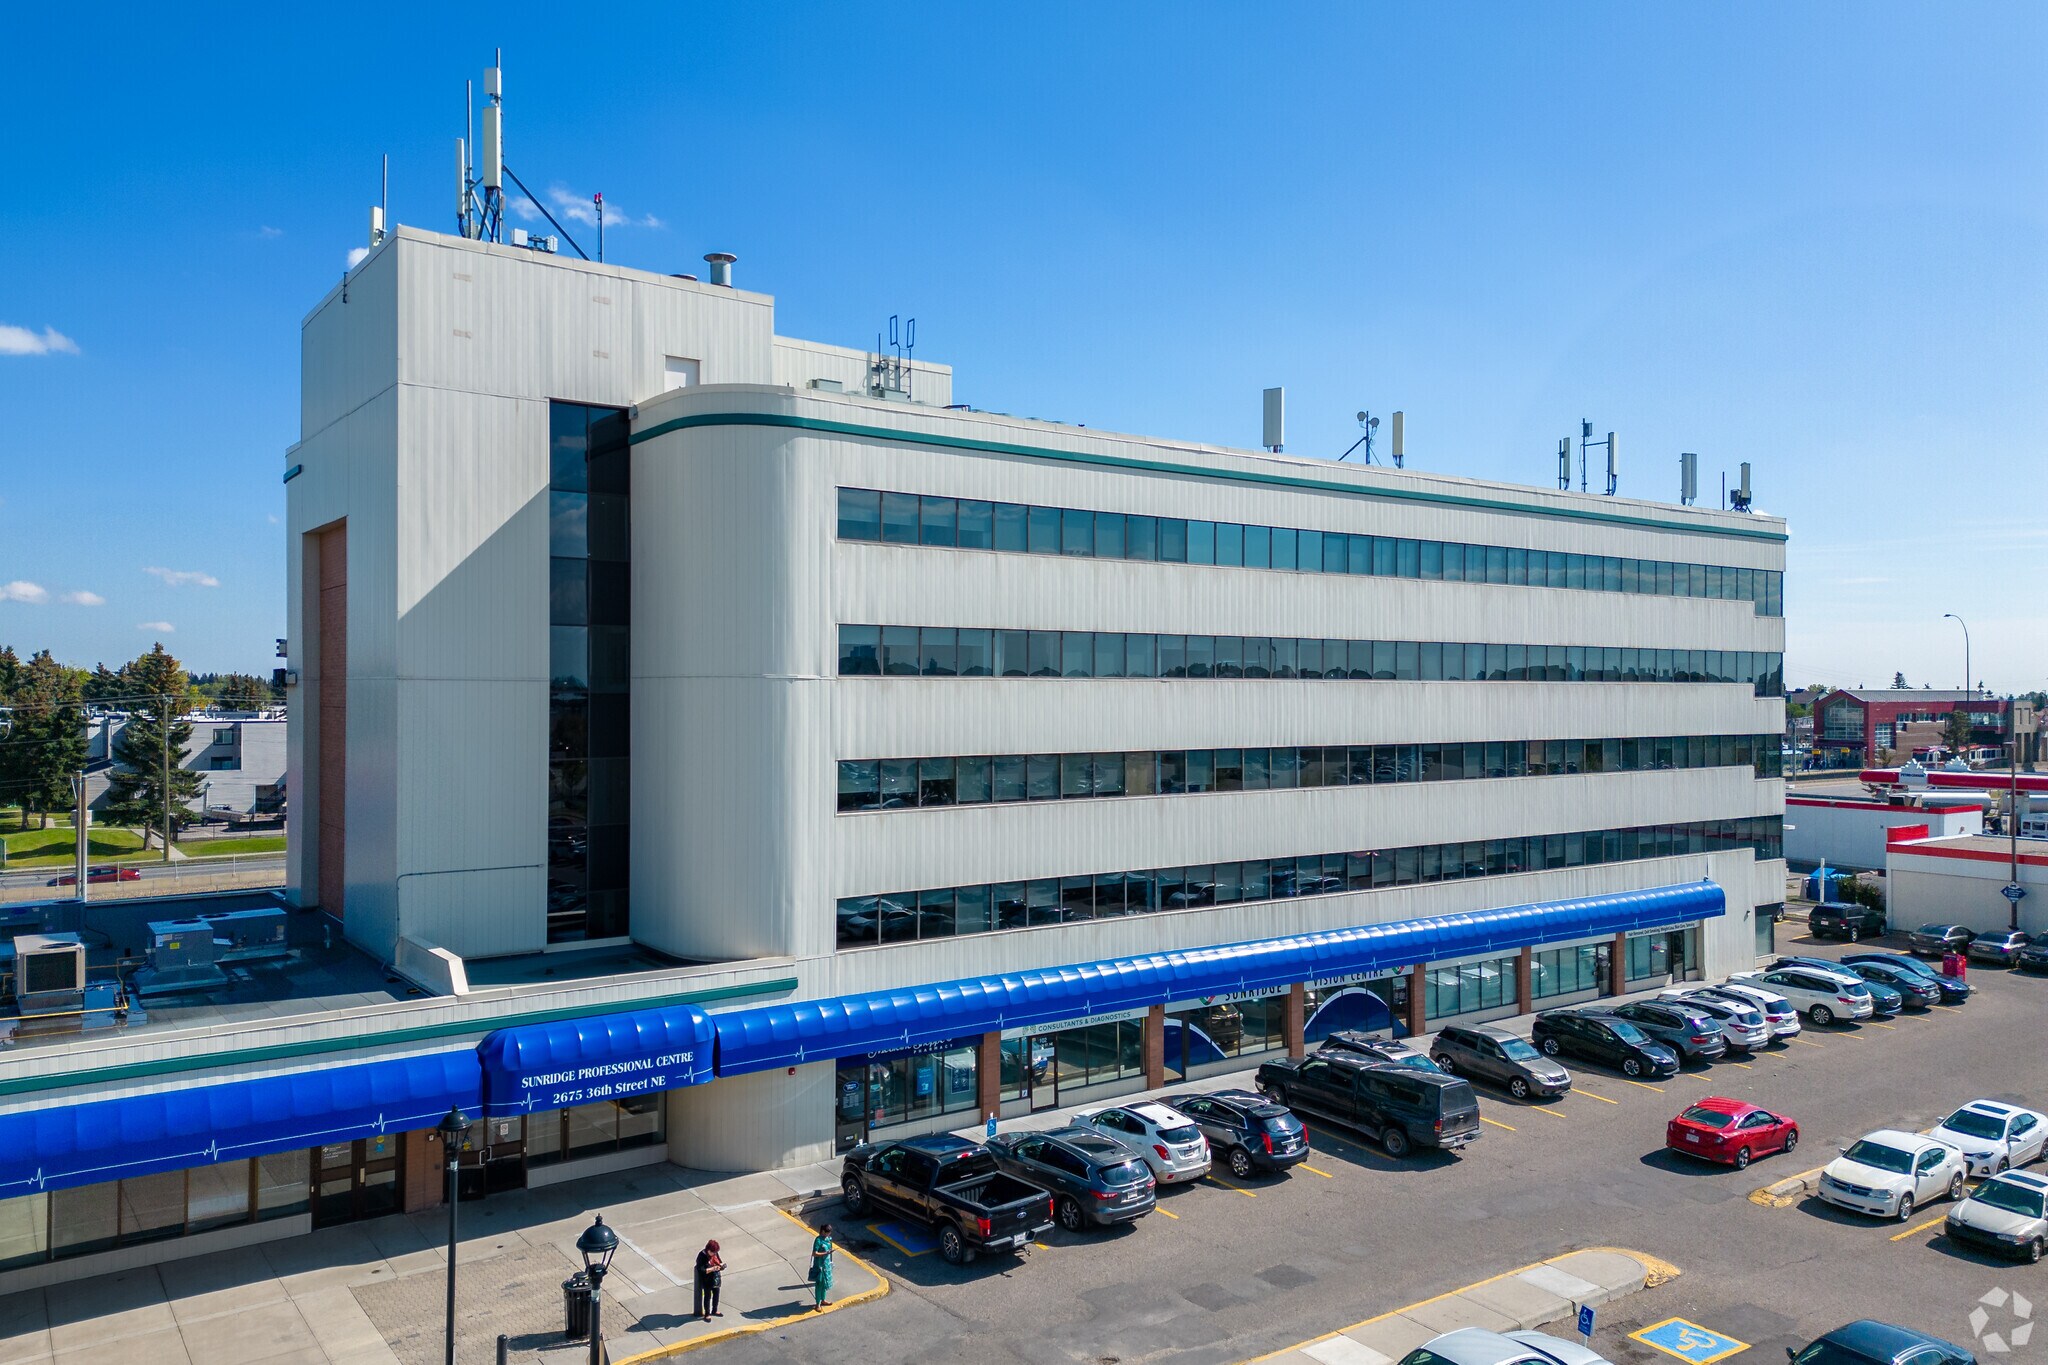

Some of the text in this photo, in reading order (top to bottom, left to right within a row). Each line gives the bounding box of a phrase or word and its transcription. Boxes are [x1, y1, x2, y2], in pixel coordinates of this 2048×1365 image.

[1038, 1018, 1083, 1032] CONSULTANTS
[1091, 1012, 1131, 1024] DIAGNOSTICS
[521, 1051, 694, 1089] SUNRIDGE PROFESSIONAL CENTRE
[552, 1075, 666, 1104] 2675 36th Street NE
